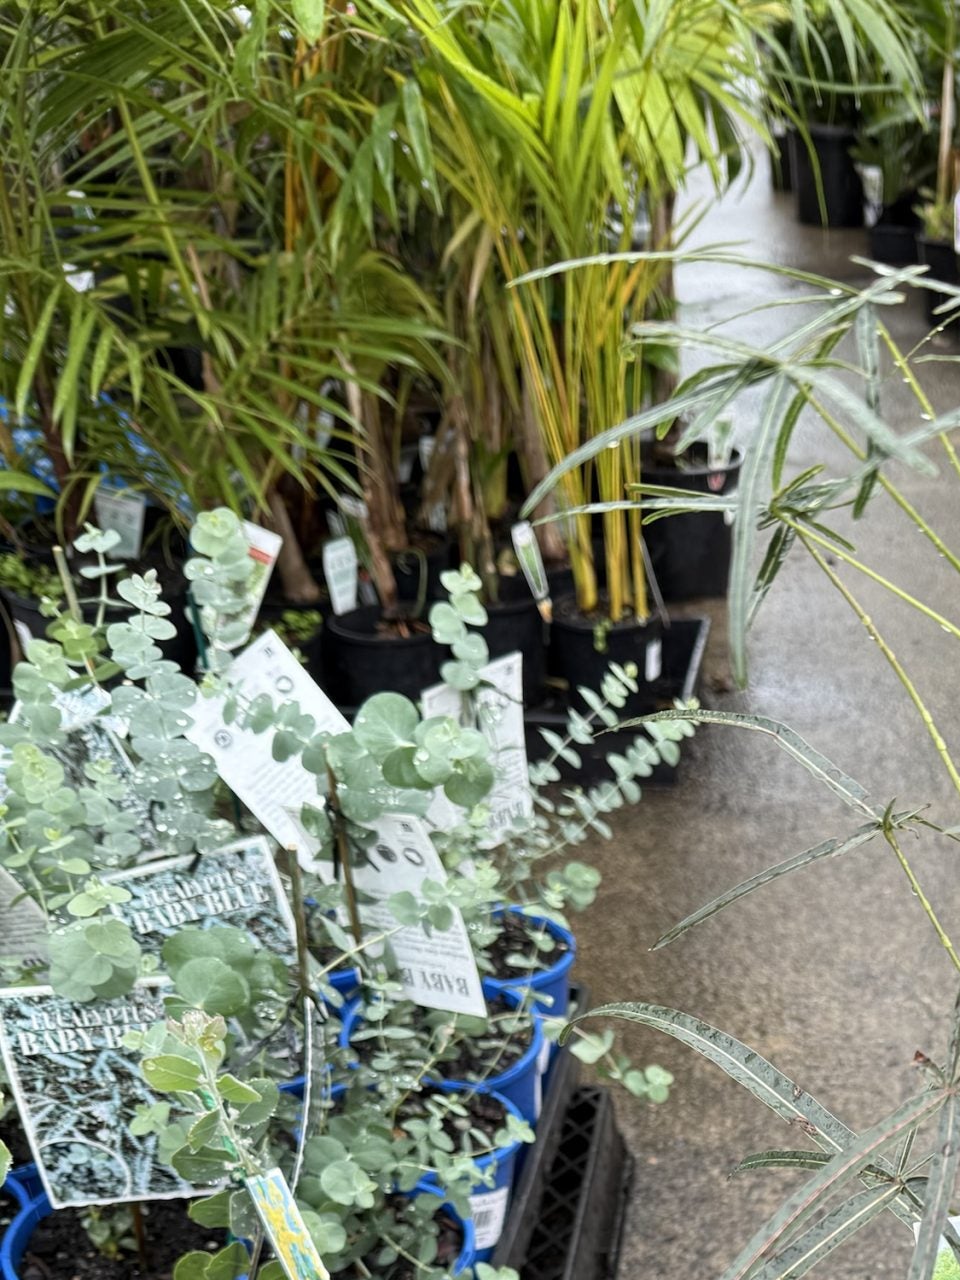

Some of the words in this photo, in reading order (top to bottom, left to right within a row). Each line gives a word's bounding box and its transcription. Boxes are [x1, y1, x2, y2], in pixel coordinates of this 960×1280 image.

[131, 898, 200, 935] BABY
[203, 882, 269, 915] BLUE
[421, 970, 470, 998] BABY
[31, 1005, 157, 1030] EUCALYPTUS
[17, 1027, 95, 1056] BABY
